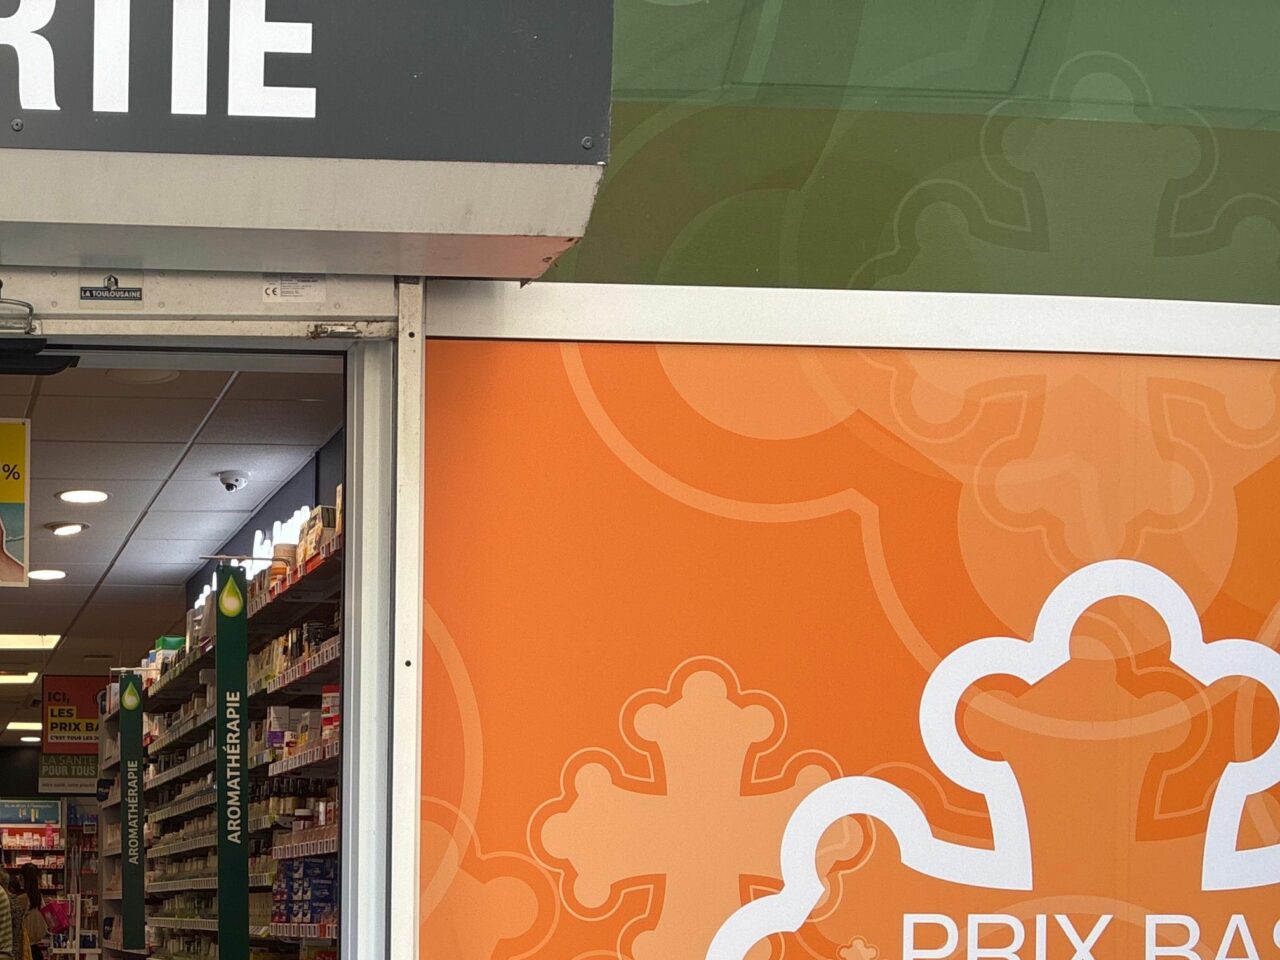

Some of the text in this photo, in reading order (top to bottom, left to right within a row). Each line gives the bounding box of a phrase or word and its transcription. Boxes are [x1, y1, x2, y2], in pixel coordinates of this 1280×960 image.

[92, 290, 141, 298] TOULOUSAINE
[47, 691, 70, 704] ICI,
[50, 708, 75, 718] LES
[50, 722, 82, 732] PRIX
[42, 765, 96, 776] POUR TOUS
[222, 690, 241, 844] AROMATHÉRAPIE
[124, 760, 139, 865] AROMATHÉRAPIE
